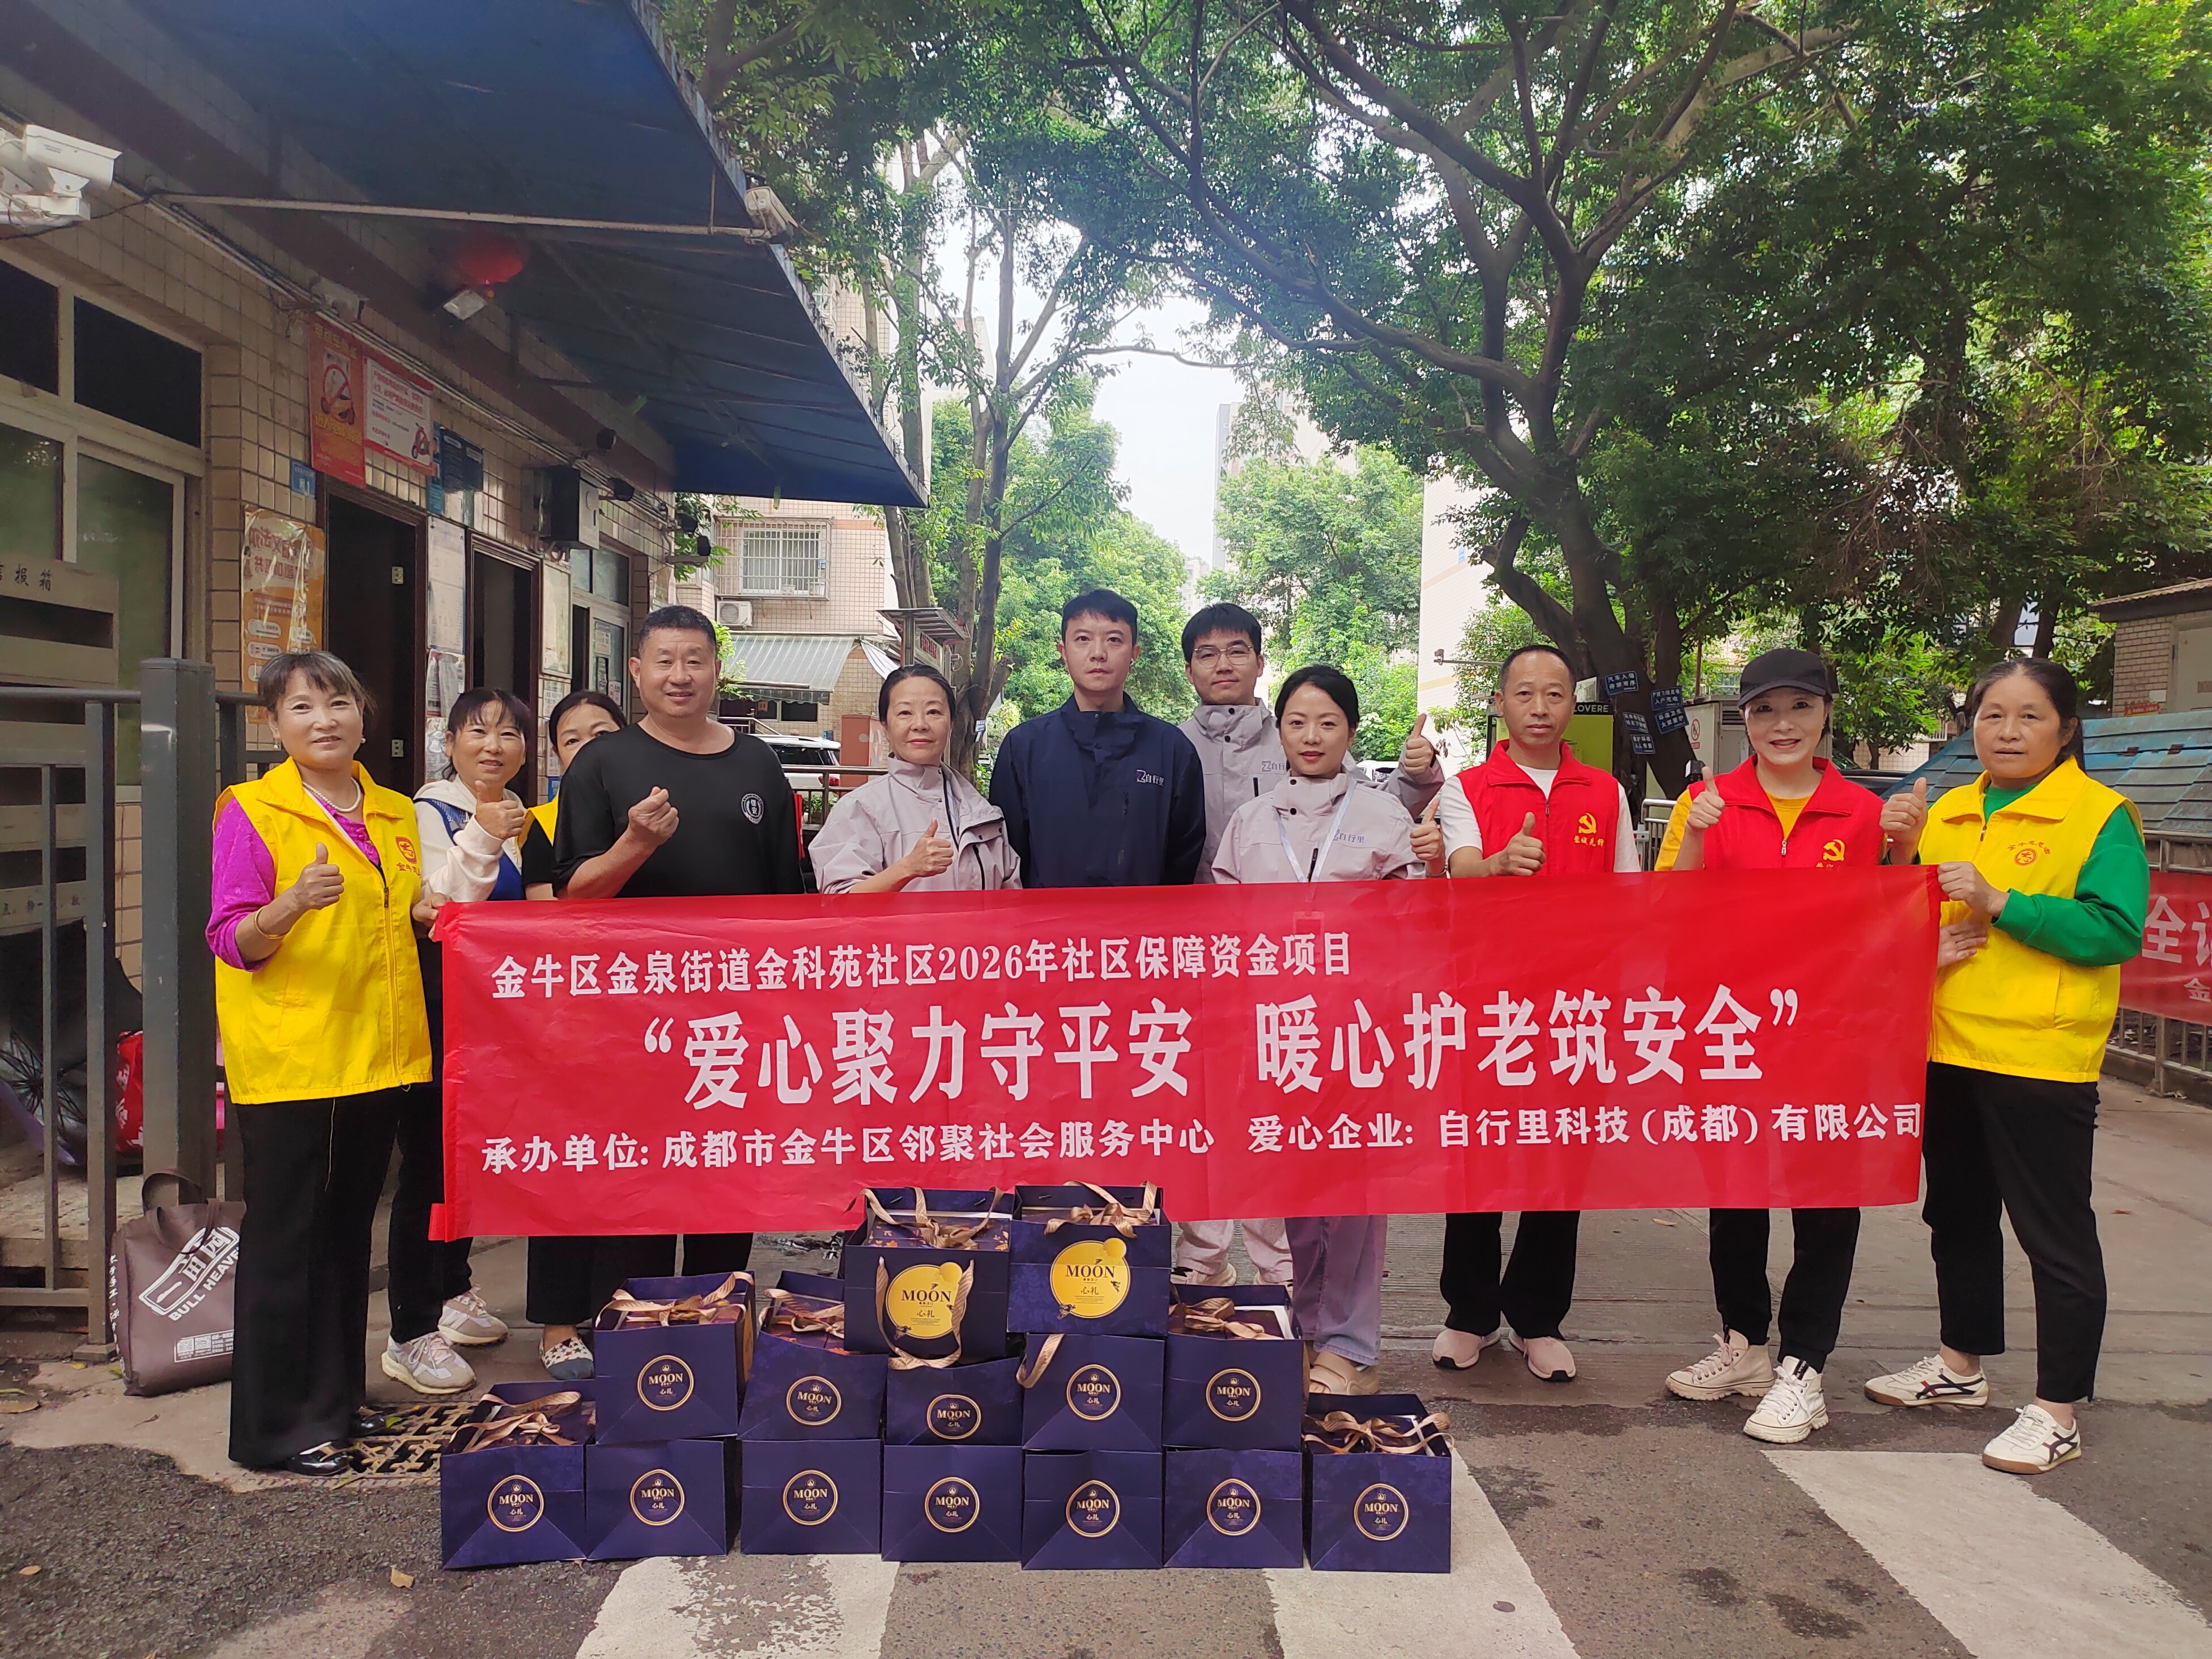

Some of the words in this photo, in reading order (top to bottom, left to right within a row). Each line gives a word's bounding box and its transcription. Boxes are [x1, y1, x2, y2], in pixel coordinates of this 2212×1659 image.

[751, 799, 758, 815] 保安
[491, 931, 1350, 999] 金牛区金泉街道金科苑社区2026年社区保障资金项目
[1065, 1265, 1115, 1278] MOON
[901, 1290, 951, 1302] MOON
[1081, 1286, 1099, 1295] 心礼
[168, 1294, 206, 1321] BULL
[649, 1373, 683, 1385] MOON
[1077, 1383, 1111, 1394] MOON
[1216, 1386, 1251, 1396] MOON
[797, 1392, 832, 1405] MOON
[937, 1410, 971, 1418] MOON
[499, 1494, 534, 1504] MOON
[641, 1489, 674, 1499] MOON
[794, 1488, 828, 1499] MOON
[935, 1496, 969, 1507] MOON
[1077, 1499, 1110, 1510] MOON
[1218, 1497, 1250, 1508] MOON
[1364, 1502, 1398, 1512] MOON
